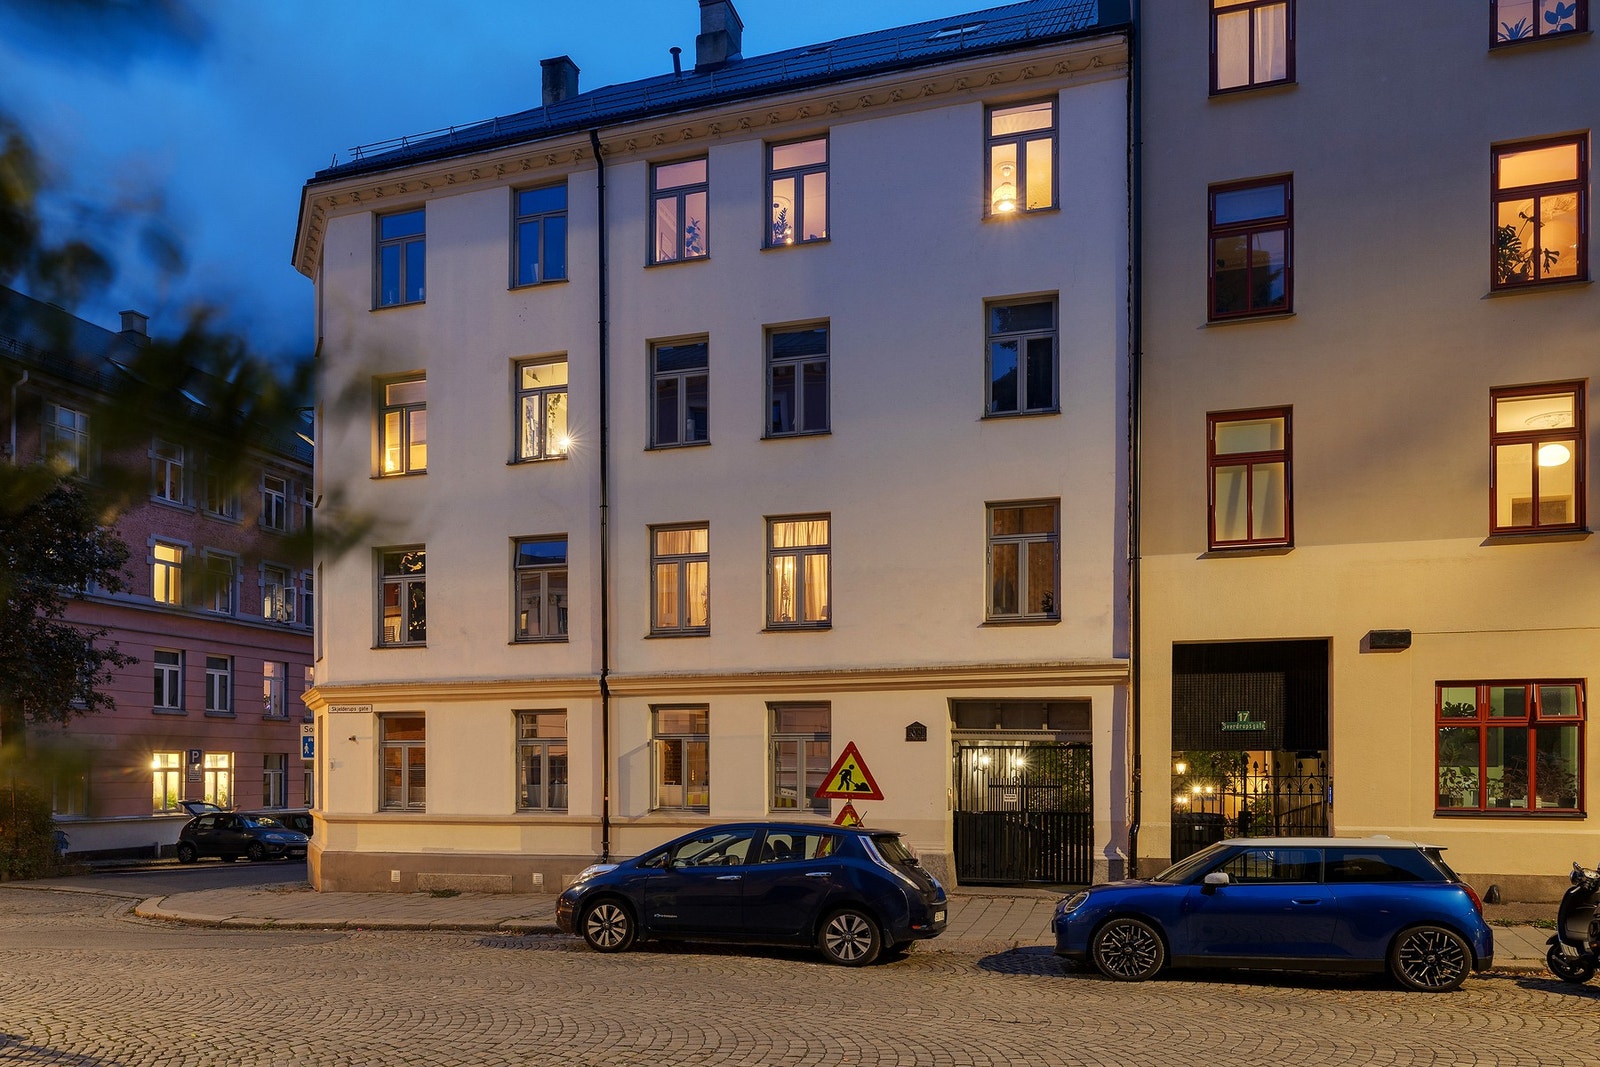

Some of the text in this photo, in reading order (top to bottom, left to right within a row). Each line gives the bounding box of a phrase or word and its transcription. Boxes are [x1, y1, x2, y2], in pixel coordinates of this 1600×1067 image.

[1238, 712, 1249, 722] 17
[304, 725, 314, 733] So
[192, 750, 200, 763] P
